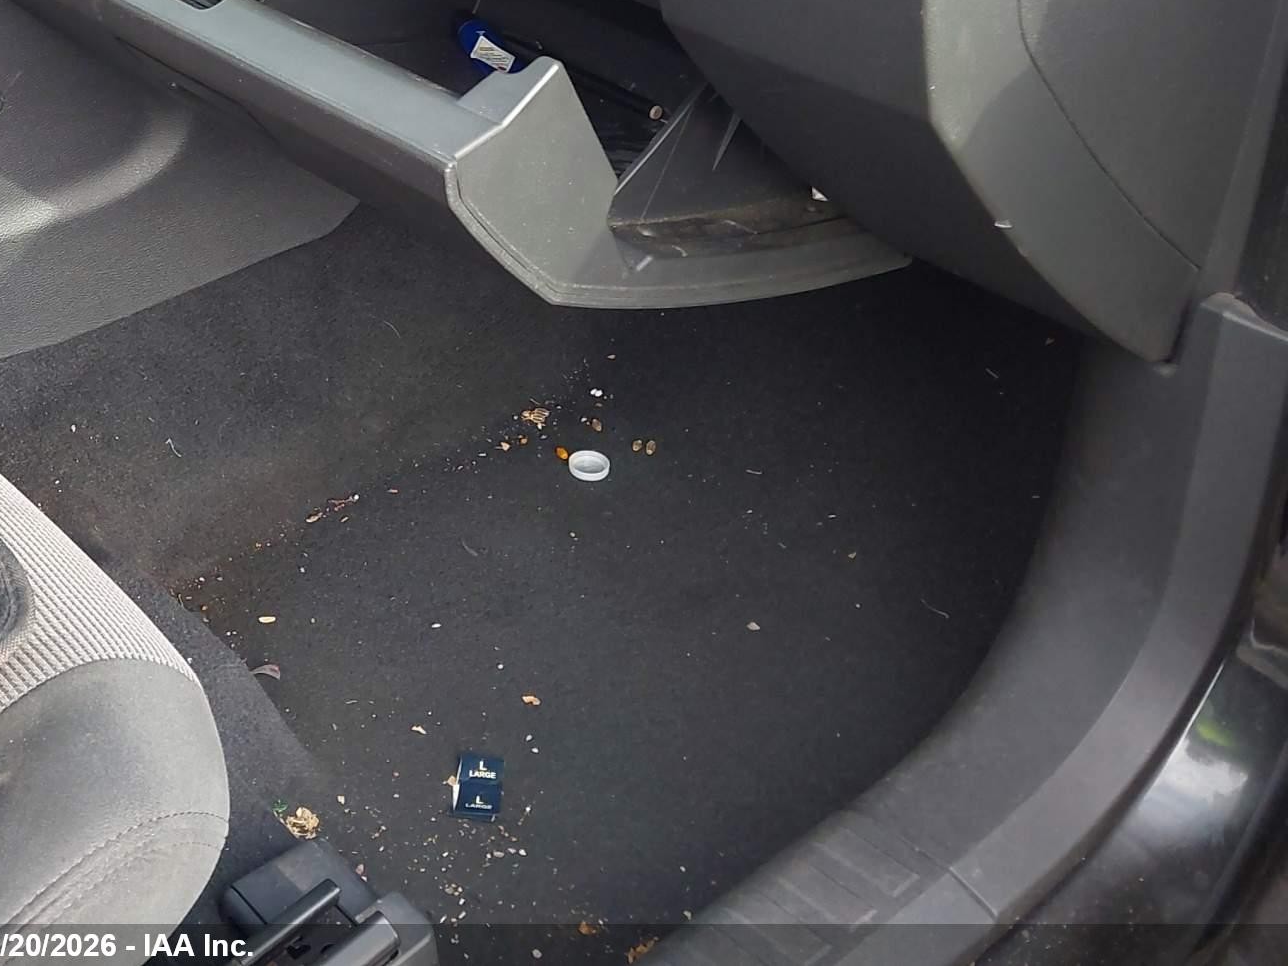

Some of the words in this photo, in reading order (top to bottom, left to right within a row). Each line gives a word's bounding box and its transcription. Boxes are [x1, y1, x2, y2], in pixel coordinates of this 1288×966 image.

[479, 760, 487, 770] L
[469, 770, 497, 779] LARGE
[476, 795, 483, 804] L
